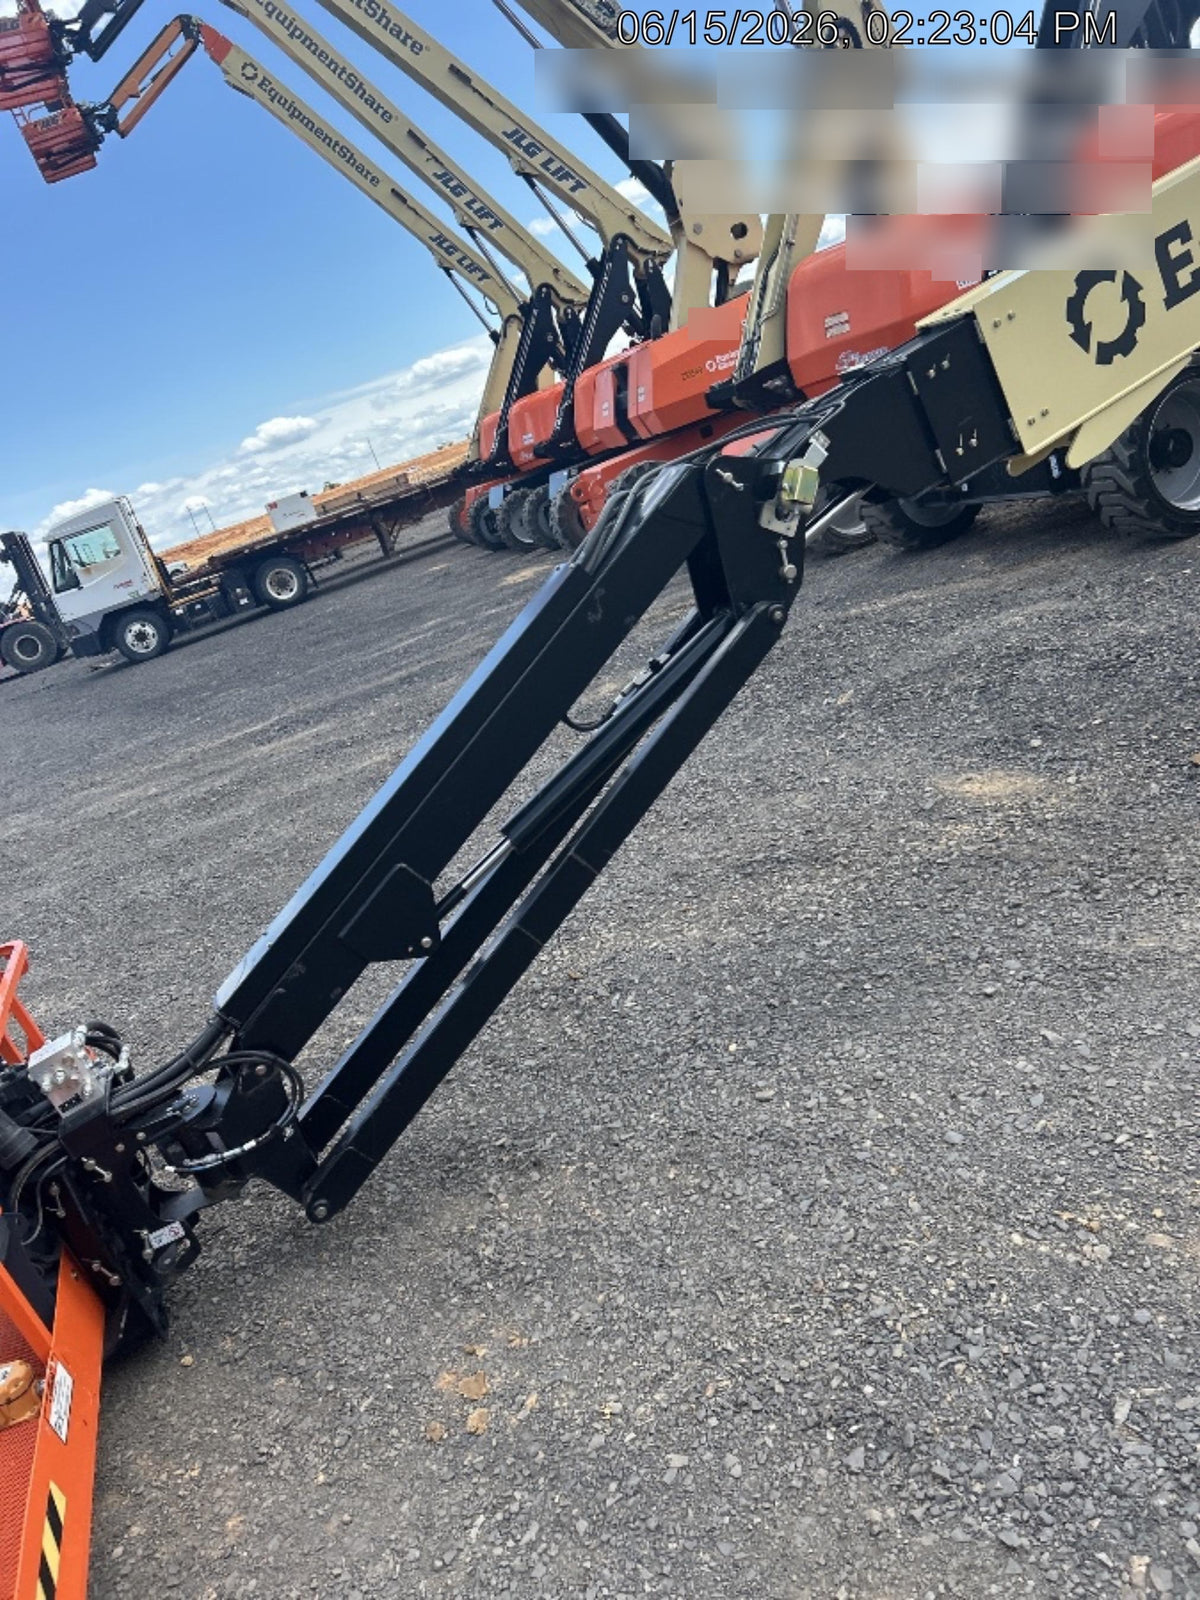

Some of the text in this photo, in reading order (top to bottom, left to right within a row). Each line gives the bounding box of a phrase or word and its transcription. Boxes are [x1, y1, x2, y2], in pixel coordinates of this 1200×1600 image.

[257, 76, 380, 187] EquipmentShare
[501, 128, 587, 193] JLG LIFT
[433, 170, 504, 229] JLG LIFT
[428, 233, 491, 281] JLG LIFT
